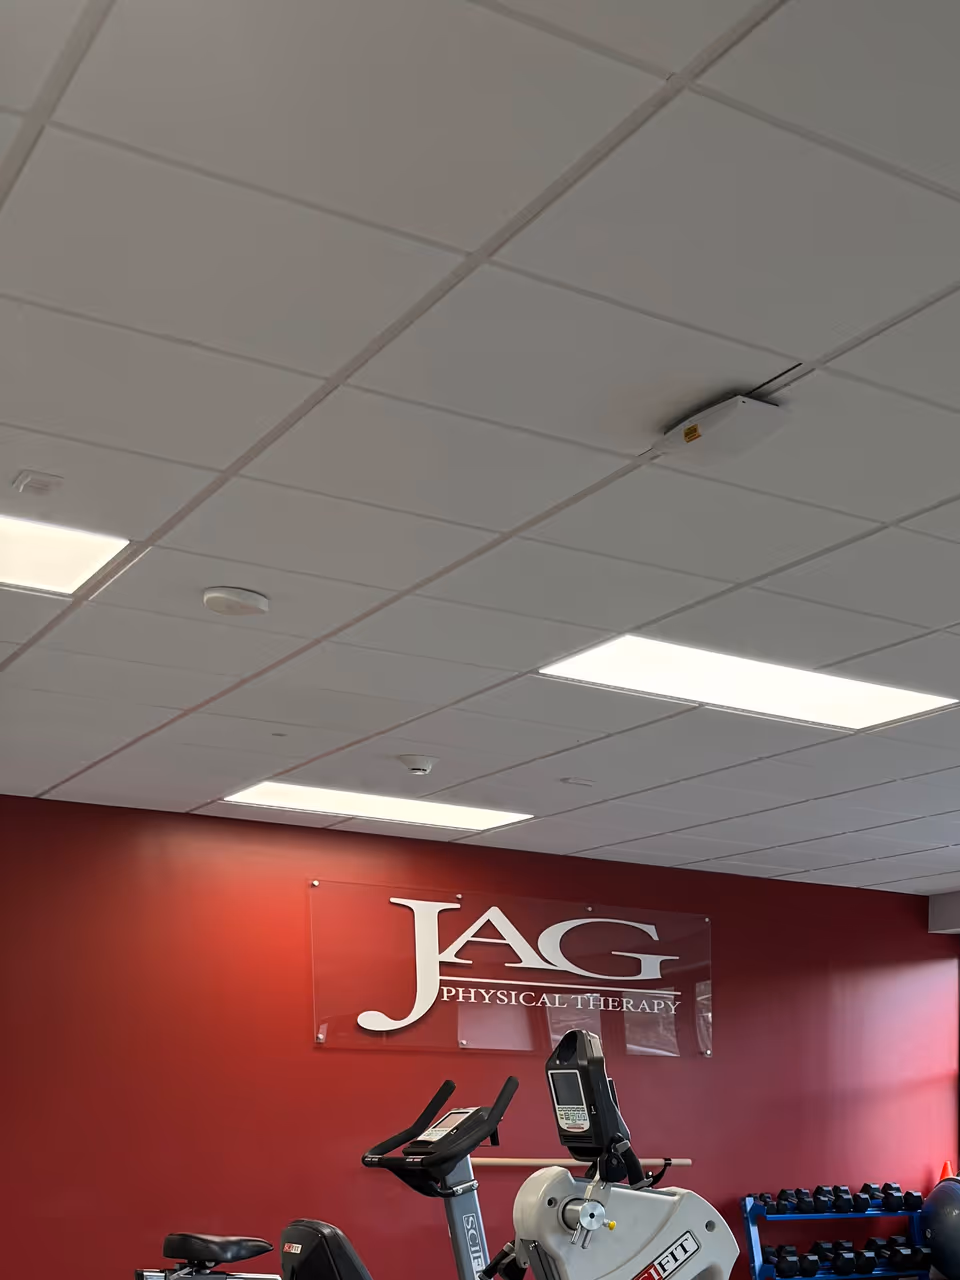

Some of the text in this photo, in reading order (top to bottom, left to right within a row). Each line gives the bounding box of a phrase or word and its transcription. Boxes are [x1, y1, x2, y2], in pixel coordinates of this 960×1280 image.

[357, 897, 681, 1032] JAG
[440, 986, 682, 1015] PHYSICAL THERAPY
